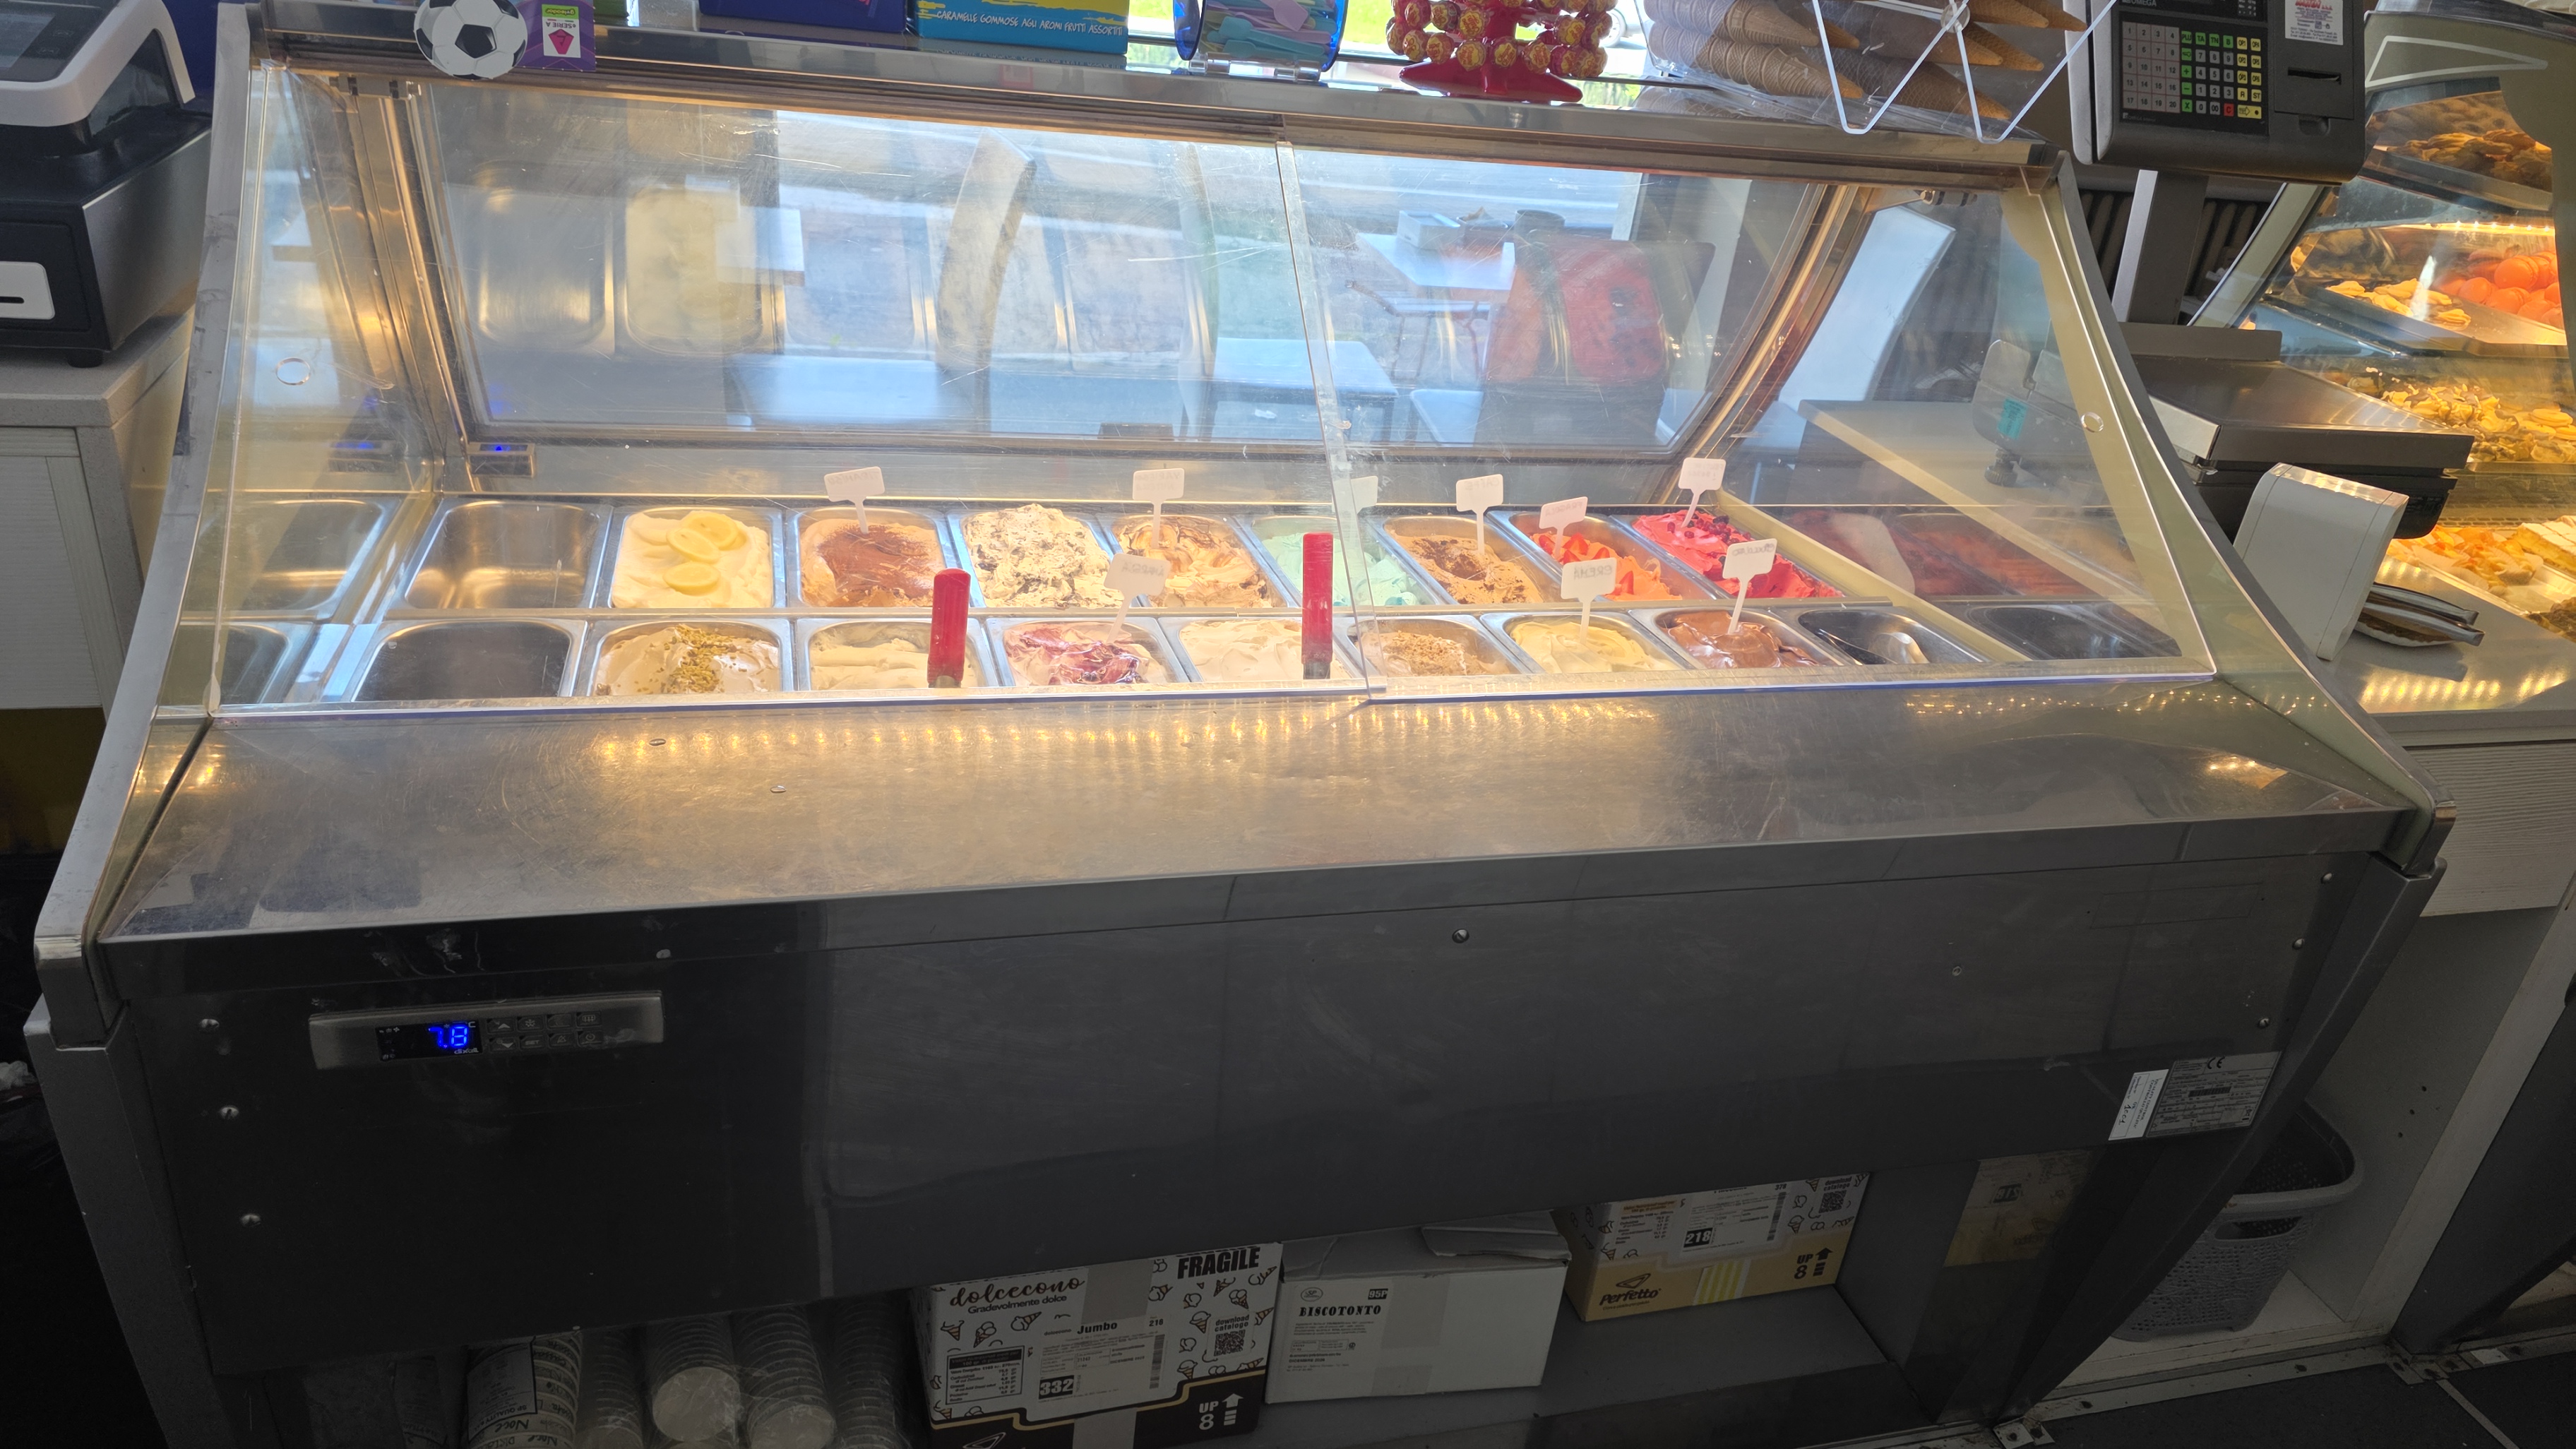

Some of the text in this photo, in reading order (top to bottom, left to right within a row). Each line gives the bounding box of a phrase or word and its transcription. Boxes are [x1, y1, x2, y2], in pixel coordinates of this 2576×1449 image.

[936, 10, 1123, 36] CARAMELLE GOMMOSE AGLI AROMI FRUTTI ASSORTITI
[2212, 70, 2217, 78] 5
[1684, 1230, 1712, 1245] 218
[1177, 1246, 1261, 1280] FRAGILE
[1796, 1253, 1814, 1264] UP
[1794, 1264, 1808, 1280] 8
[949, 1277, 1086, 1307] dolcecono
[1368, 1289, 1388, 1299] 95P
[1598, 1287, 1659, 1306] Perfetto
[967, 1294, 1067, 1314] Gradevolmente dolce
[1298, 1304, 1382, 1317] BISCOTONTO
[1076, 1321, 1118, 1335] Jumbo
[1214, 1321, 1249, 1332] catalogo
[1215, 1314, 1250, 1327] download
[1039, 1378, 1074, 1397] 332
[486, 1405, 516, 1424] QUALITY
[1198, 1400, 1220, 1414] UP
[1198, 1413, 1215, 1431] 8
